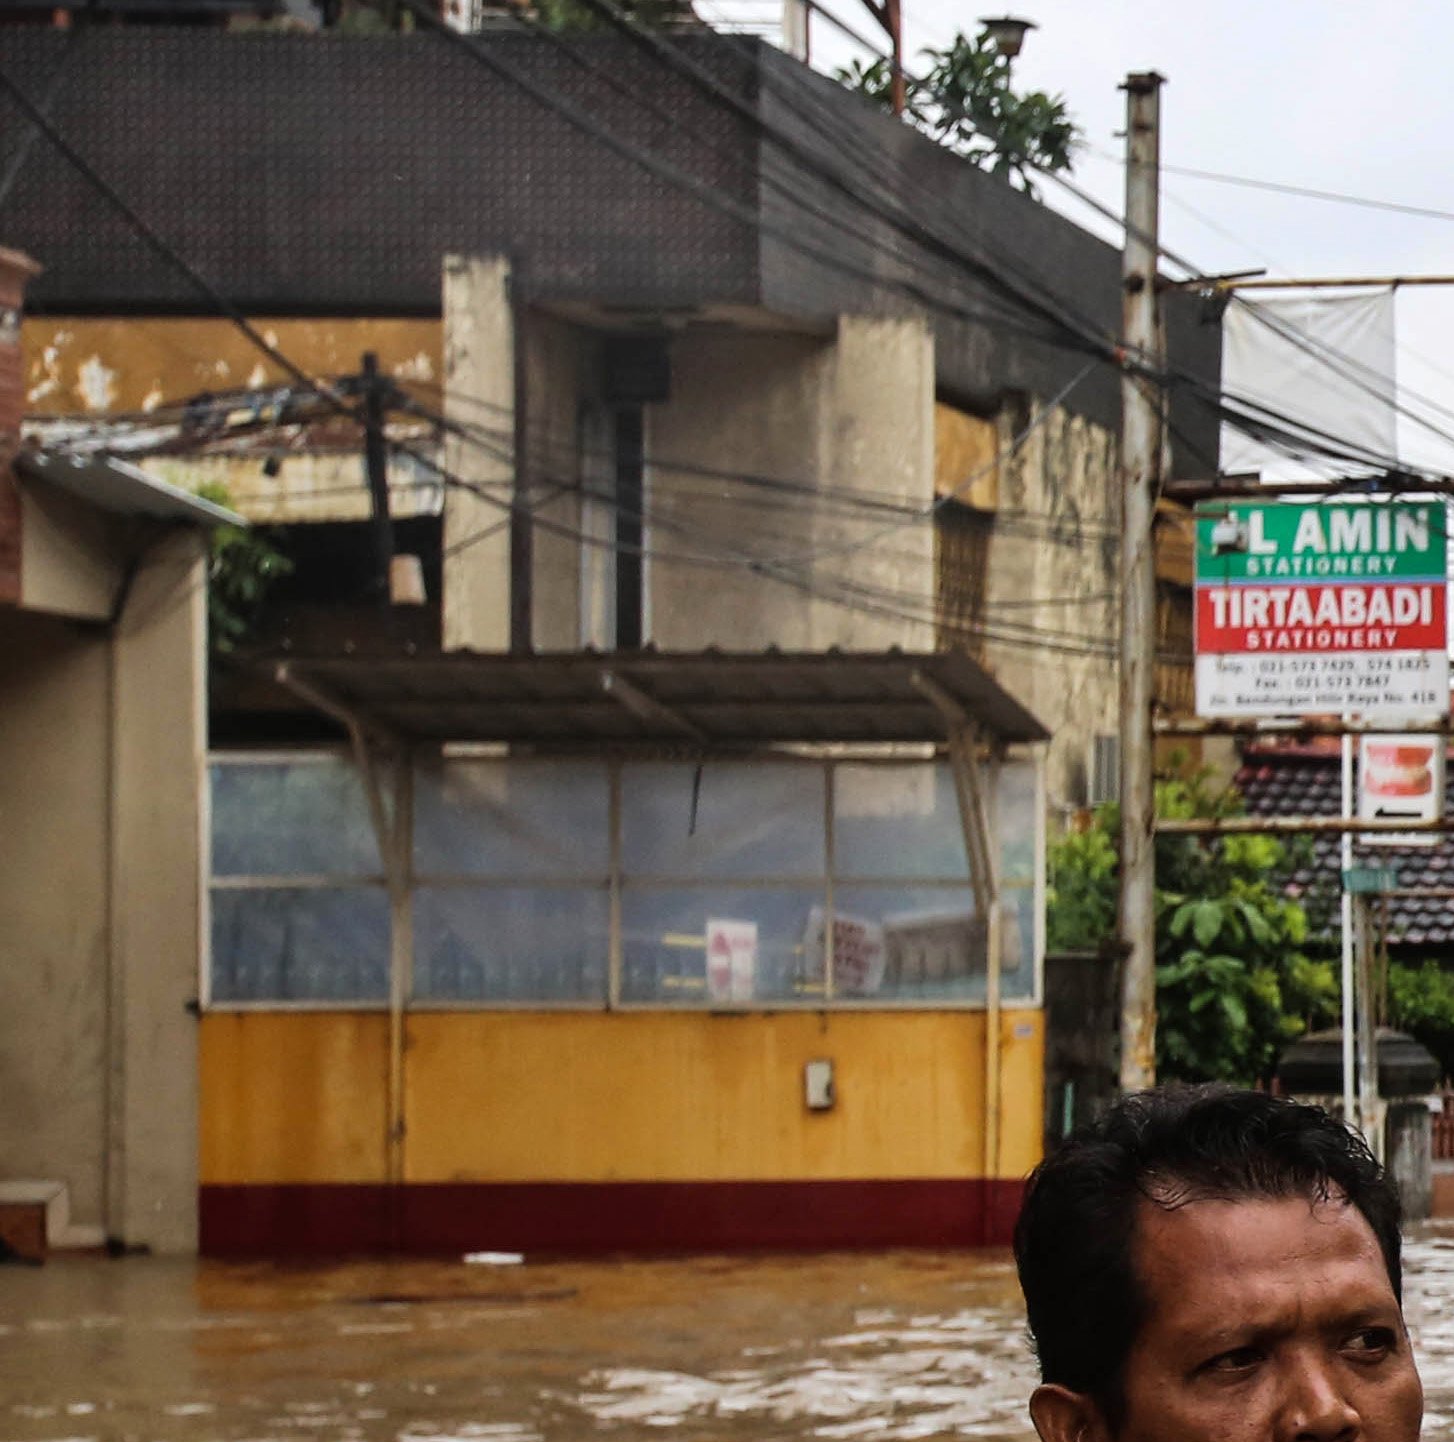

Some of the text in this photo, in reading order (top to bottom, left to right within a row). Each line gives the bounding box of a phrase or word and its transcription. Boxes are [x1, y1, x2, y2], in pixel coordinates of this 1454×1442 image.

[1292, 508, 1429, 554] AMIN
[1246, 556, 1397, 576] STATIONERY
[1209, 587, 1433, 629] TIRTAABADI
[1246, 629, 1398, 650] STATIONERY
